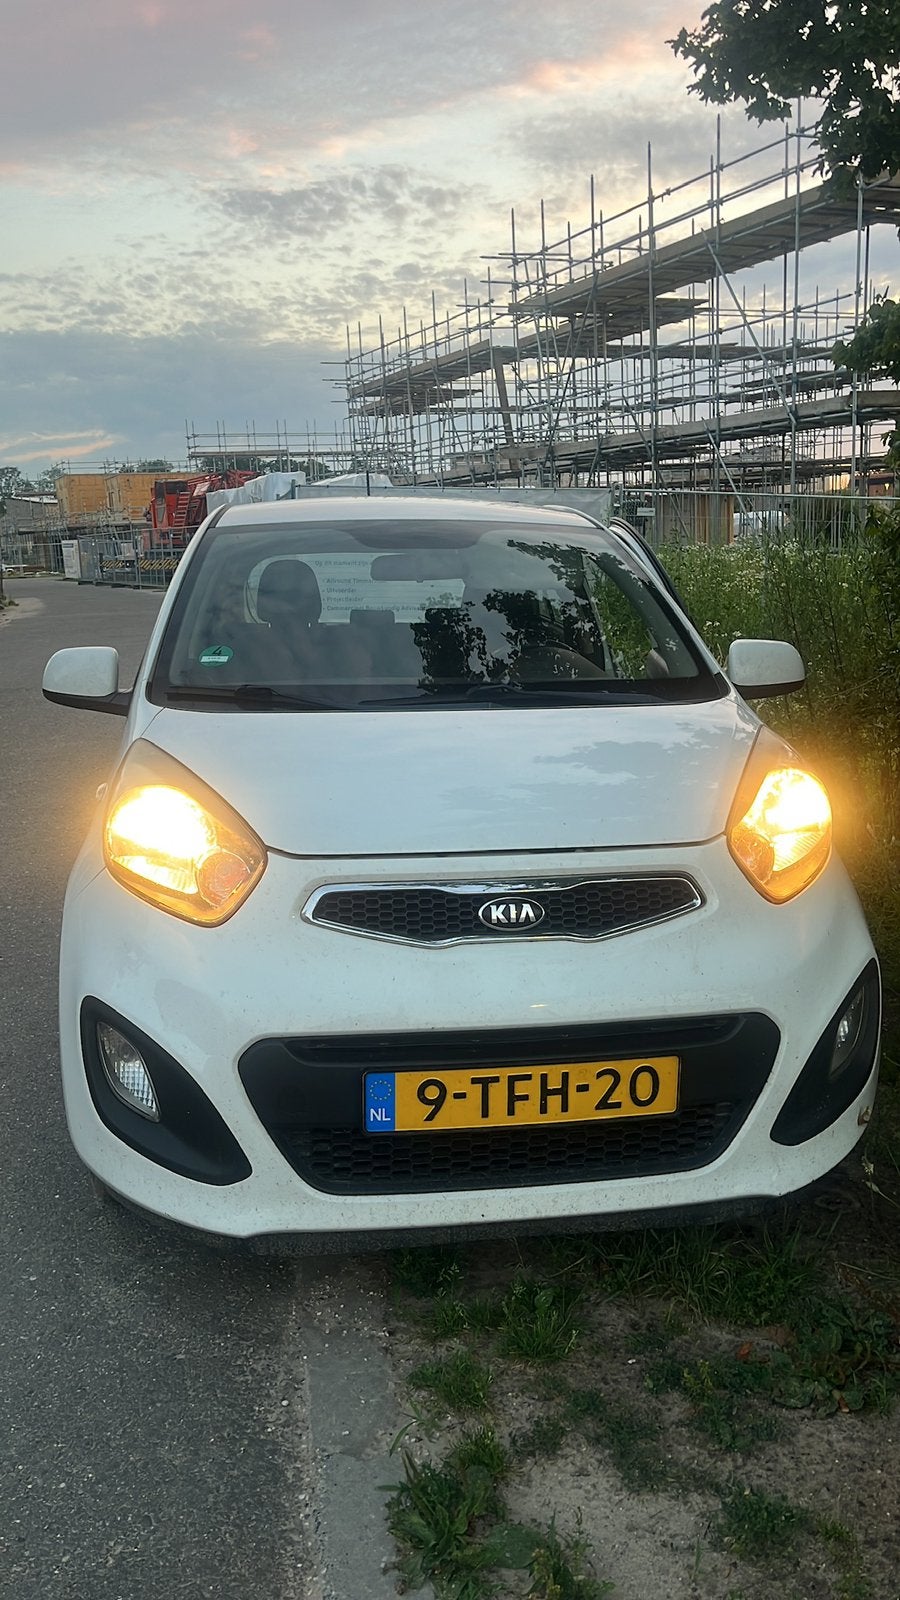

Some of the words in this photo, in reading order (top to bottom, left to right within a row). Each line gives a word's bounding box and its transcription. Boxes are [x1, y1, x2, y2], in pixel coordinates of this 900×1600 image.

[212, 646, 222, 656] 4
[490, 903, 536, 923] KIA
[416, 1063, 660, 1121] 9-TFH-20
[370, 1108, 391, 1121] NL
